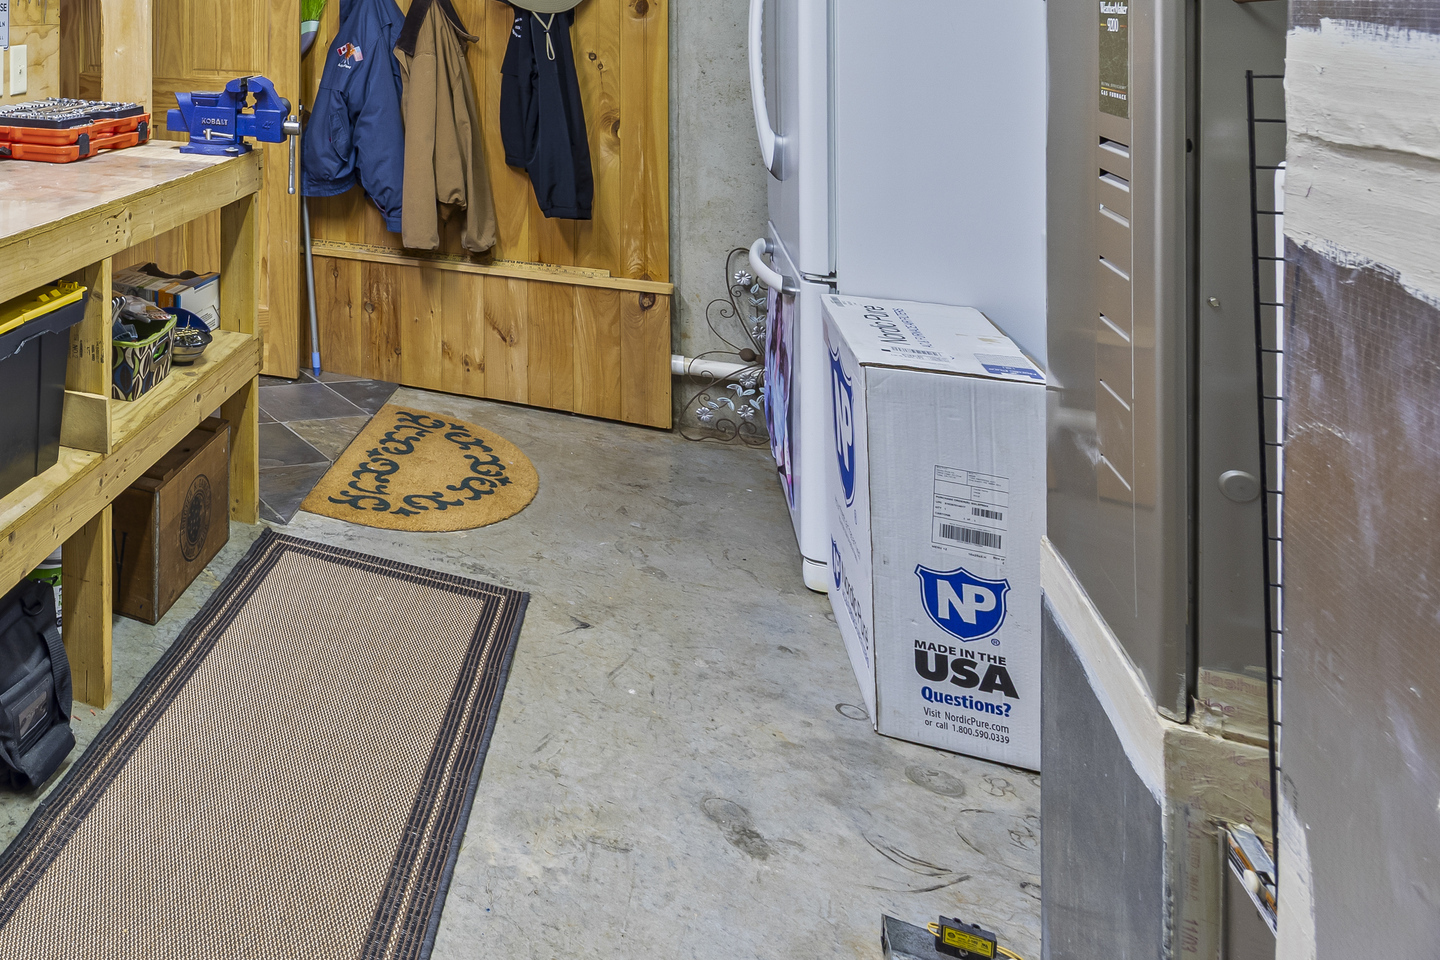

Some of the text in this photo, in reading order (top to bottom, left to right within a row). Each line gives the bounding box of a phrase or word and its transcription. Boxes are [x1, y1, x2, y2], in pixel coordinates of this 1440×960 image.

[1100, 1, 1128, 15] WeatherMaker
[1107, 18, 1119, 32] 9200
[1109, 90, 1127, 100] FURNACE
[202, 117, 228, 126] KOBALT
[936, 578, 997, 625] NP
[914, 640, 1006, 666] MADE IN THE
[914, 648, 1020, 700] USA
[921, 686, 1012, 718] Questions?
[924, 706, 1010, 734] Visit NordicPure.com
[936, 720, 948, 730] call
[952, 724, 1010, 744] 1.800.590.0339
